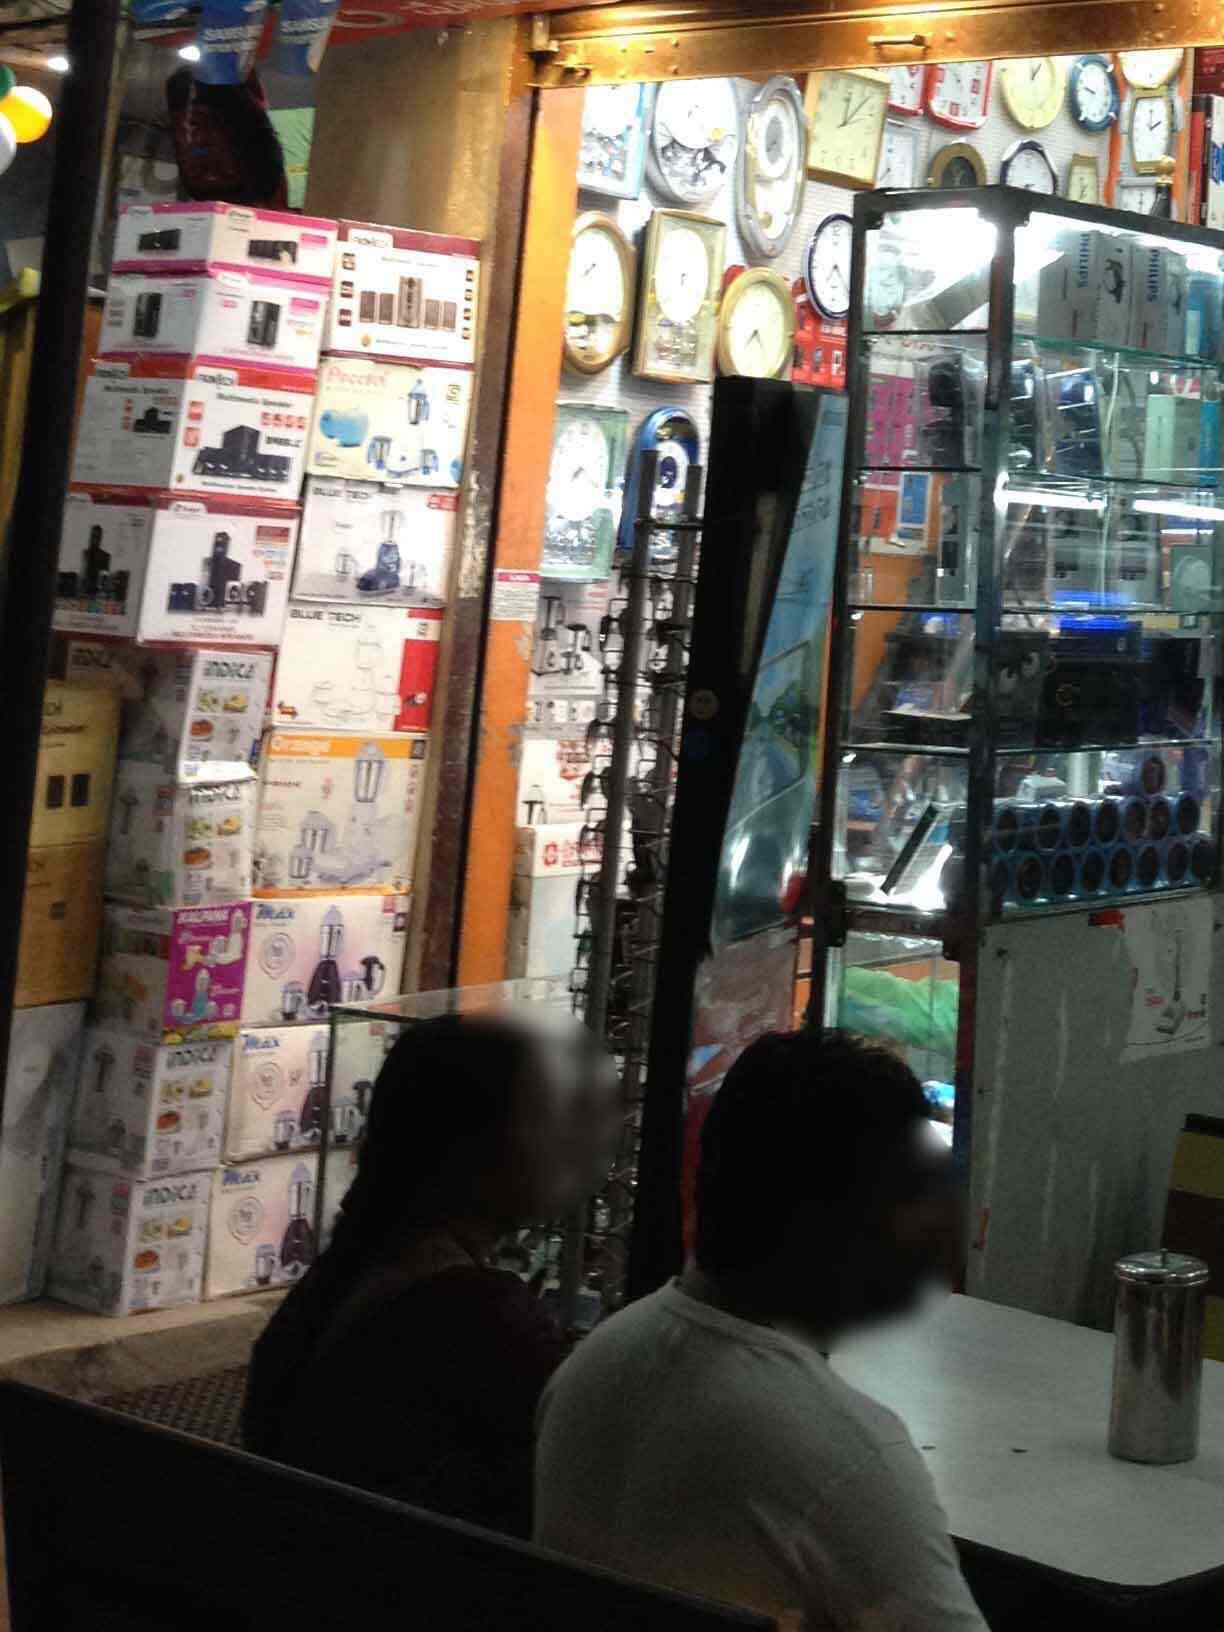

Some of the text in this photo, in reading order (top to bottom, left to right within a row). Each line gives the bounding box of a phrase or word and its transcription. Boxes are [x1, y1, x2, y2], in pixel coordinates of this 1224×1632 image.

[1079, 233, 1090, 288] PHILIPS
[1147, 249, 1160, 303] PHILIPS
[289, 610, 361, 625] BLUE TECH
